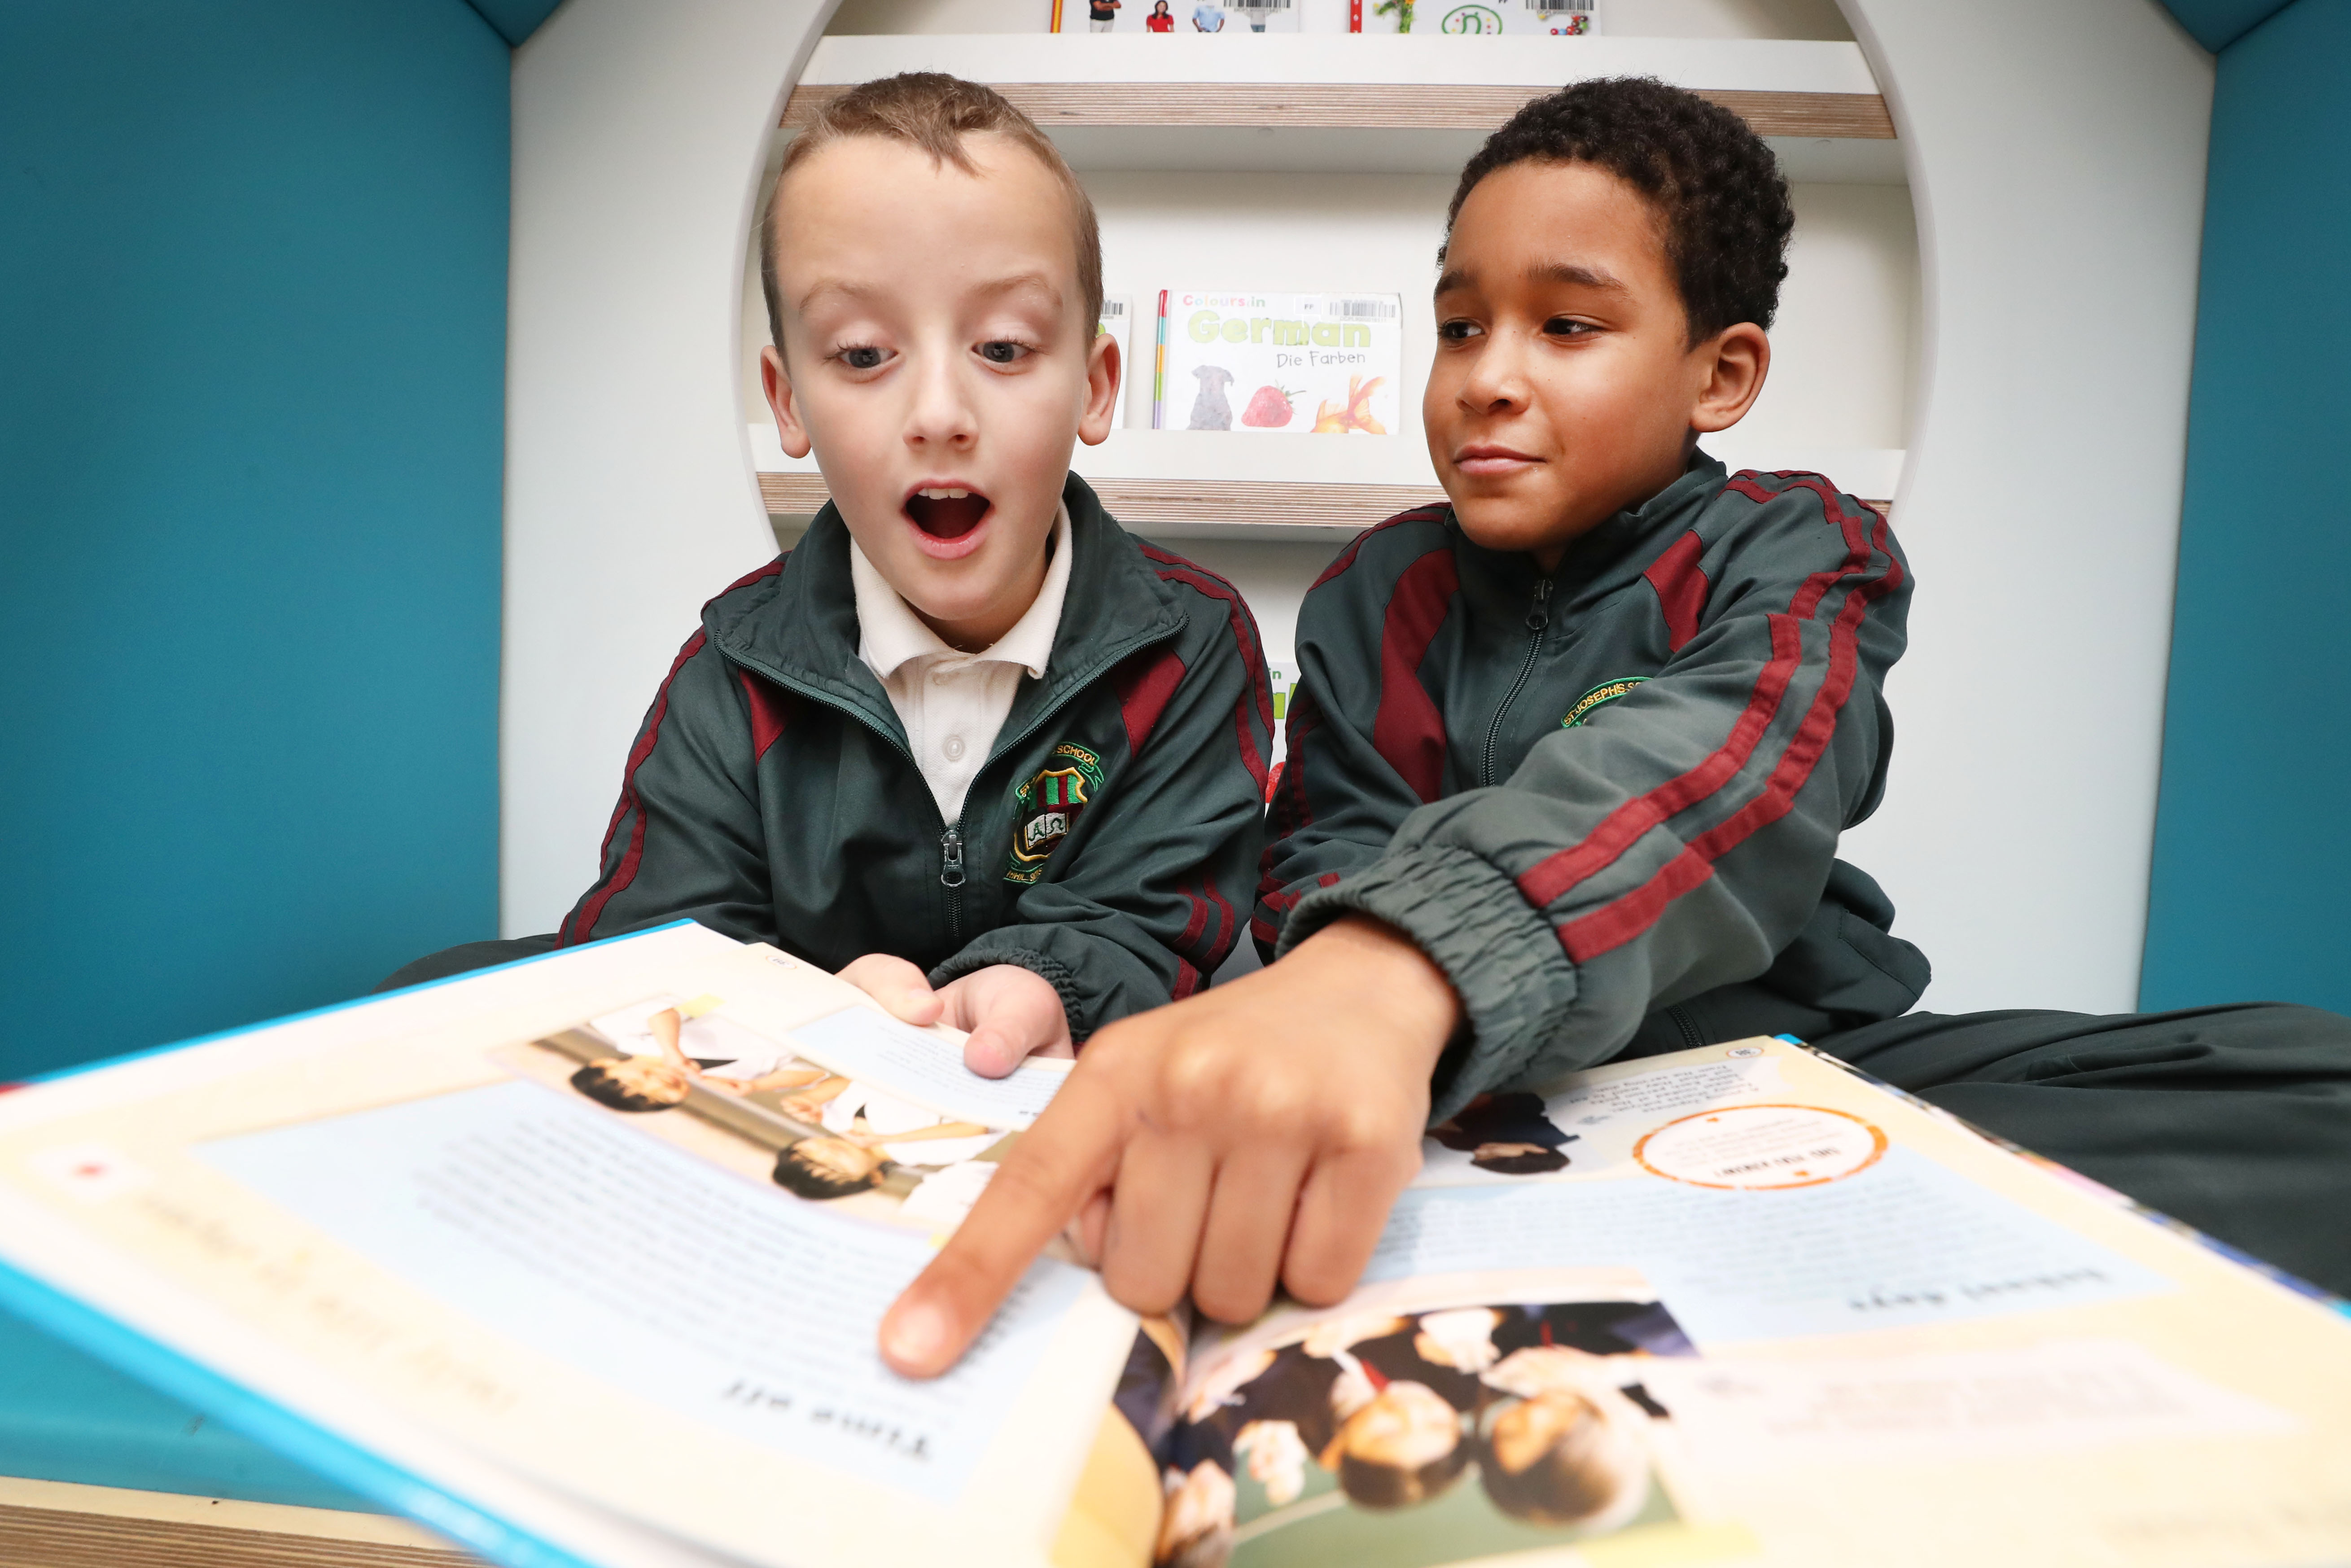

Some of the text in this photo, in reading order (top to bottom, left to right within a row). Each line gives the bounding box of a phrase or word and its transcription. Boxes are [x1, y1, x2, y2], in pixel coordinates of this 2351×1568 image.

[1183, 294, 1265, 307] Colours in
[1188, 309, 1371, 348] German
[1276, 350, 1366, 368] Die Farben
[1576, 683, 1626, 714] JOSEPH'S
[1057, 745, 1095, 766] SCHOOL
